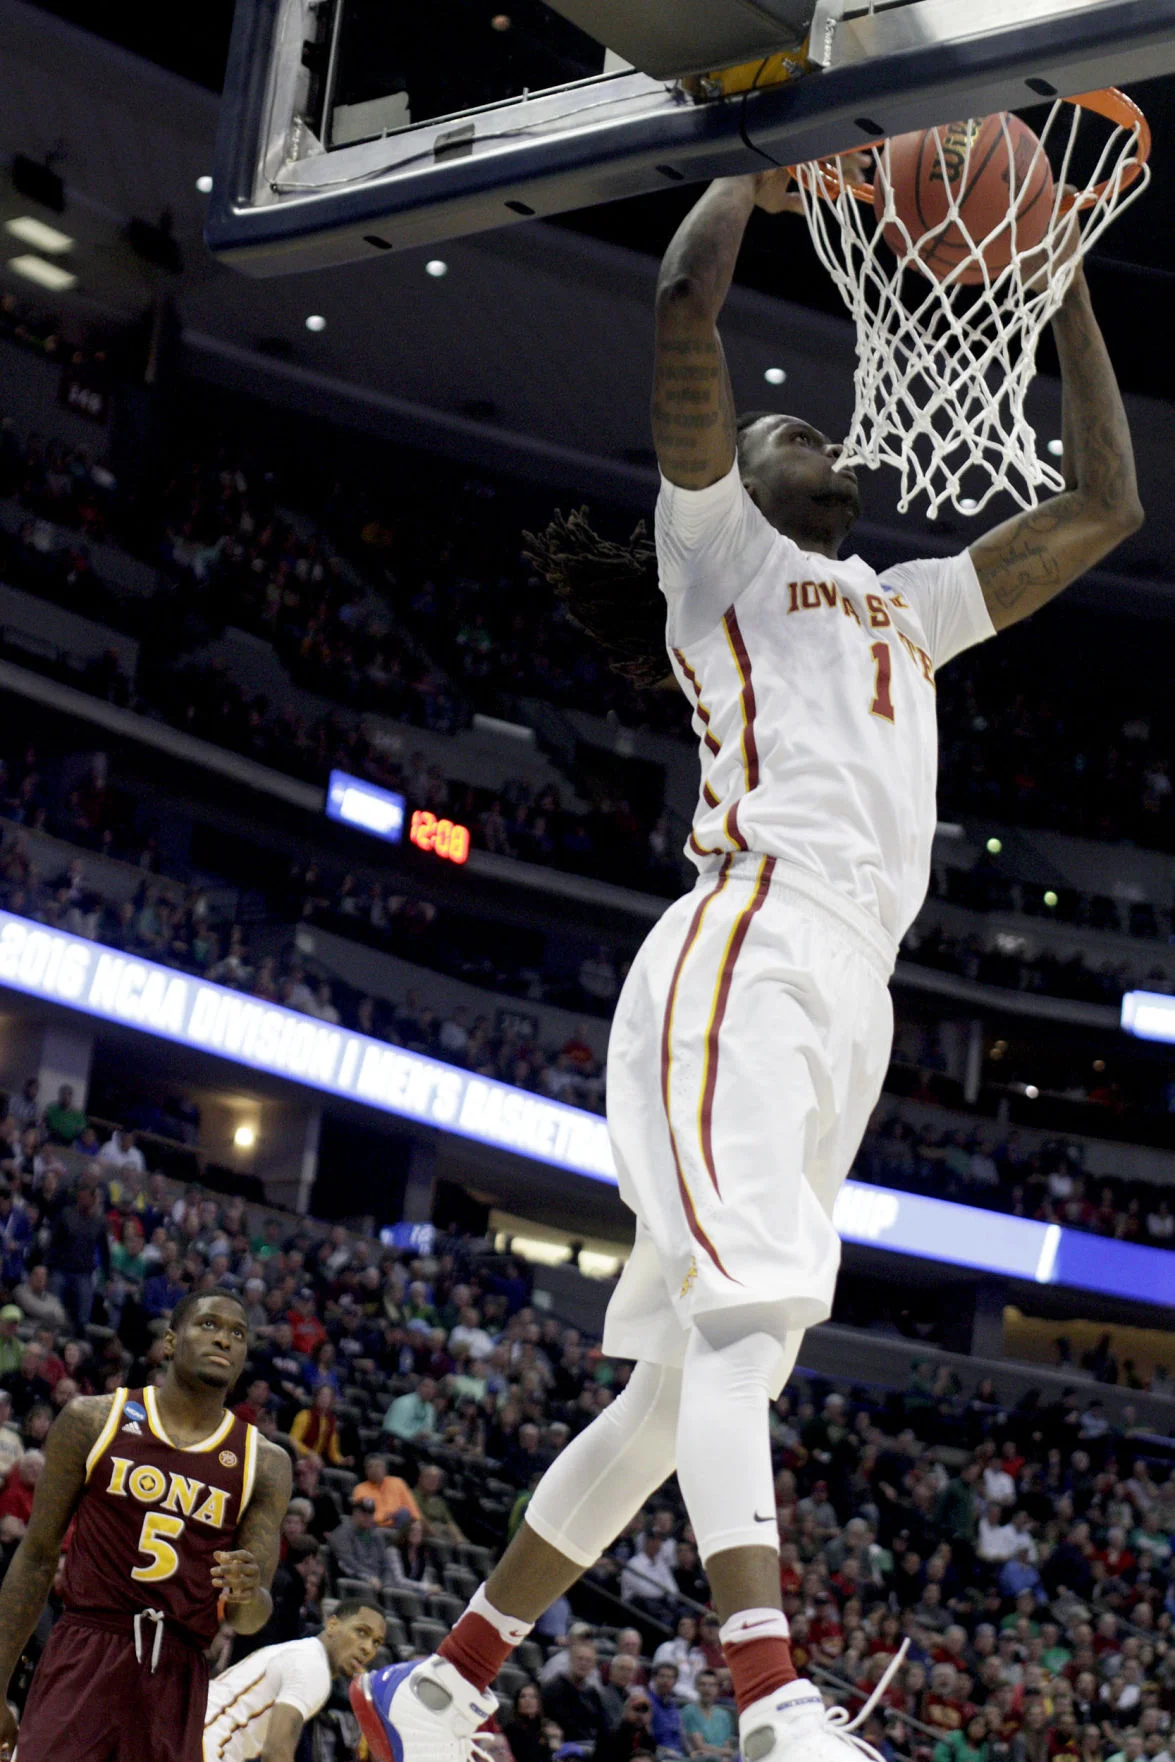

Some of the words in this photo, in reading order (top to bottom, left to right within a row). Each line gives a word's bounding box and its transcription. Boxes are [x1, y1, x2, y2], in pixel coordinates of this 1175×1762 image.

[787, 579, 861, 628] IOWA
[868, 640, 896, 725] 1
[410, 810, 471, 865] 12:08
[0, 922, 92, 999] 2016
[88, 953, 188, 1033] NCAA
[187, 986, 342, 1083] DIVISION
[337, 1038, 360, 1089] I
[356, 1045, 463, 1120] MEN'S
[458, 1080, 619, 1177] BASKETBA
[106, 1456, 232, 1530] IONA
[131, 1511, 185, 1583] 5
